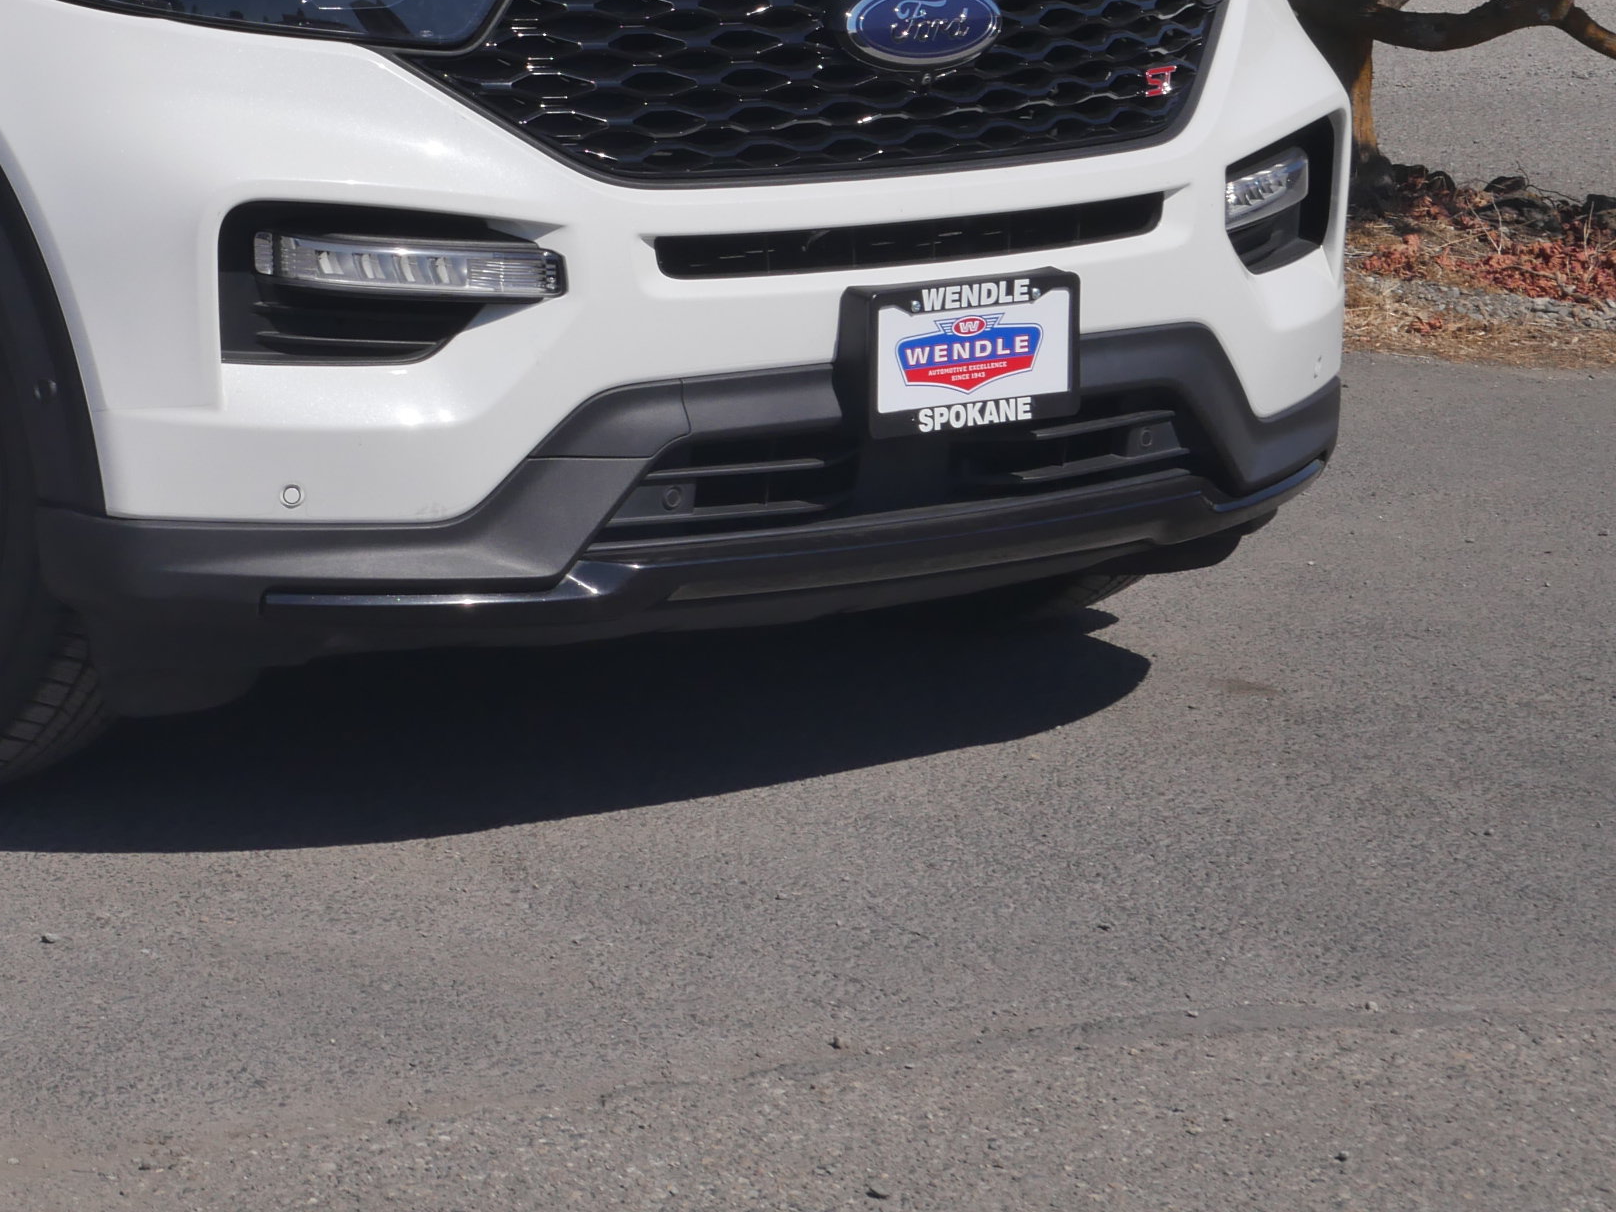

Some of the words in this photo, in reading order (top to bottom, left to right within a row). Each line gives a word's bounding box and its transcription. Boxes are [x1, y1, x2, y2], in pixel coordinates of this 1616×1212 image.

[890, 0, 970, 41] Ford
[1146, 65, 1177, 97] ST
[921, 278, 1030, 312] WENDLE
[904, 335, 1030, 366] WENDLE
[928, 366, 968, 376] AUTOMOTIVE
[968, 361, 1007, 371] EXCELLENCE
[951, 373, 970, 381] SINCE
[918, 396, 1033, 433] SPOKANE
